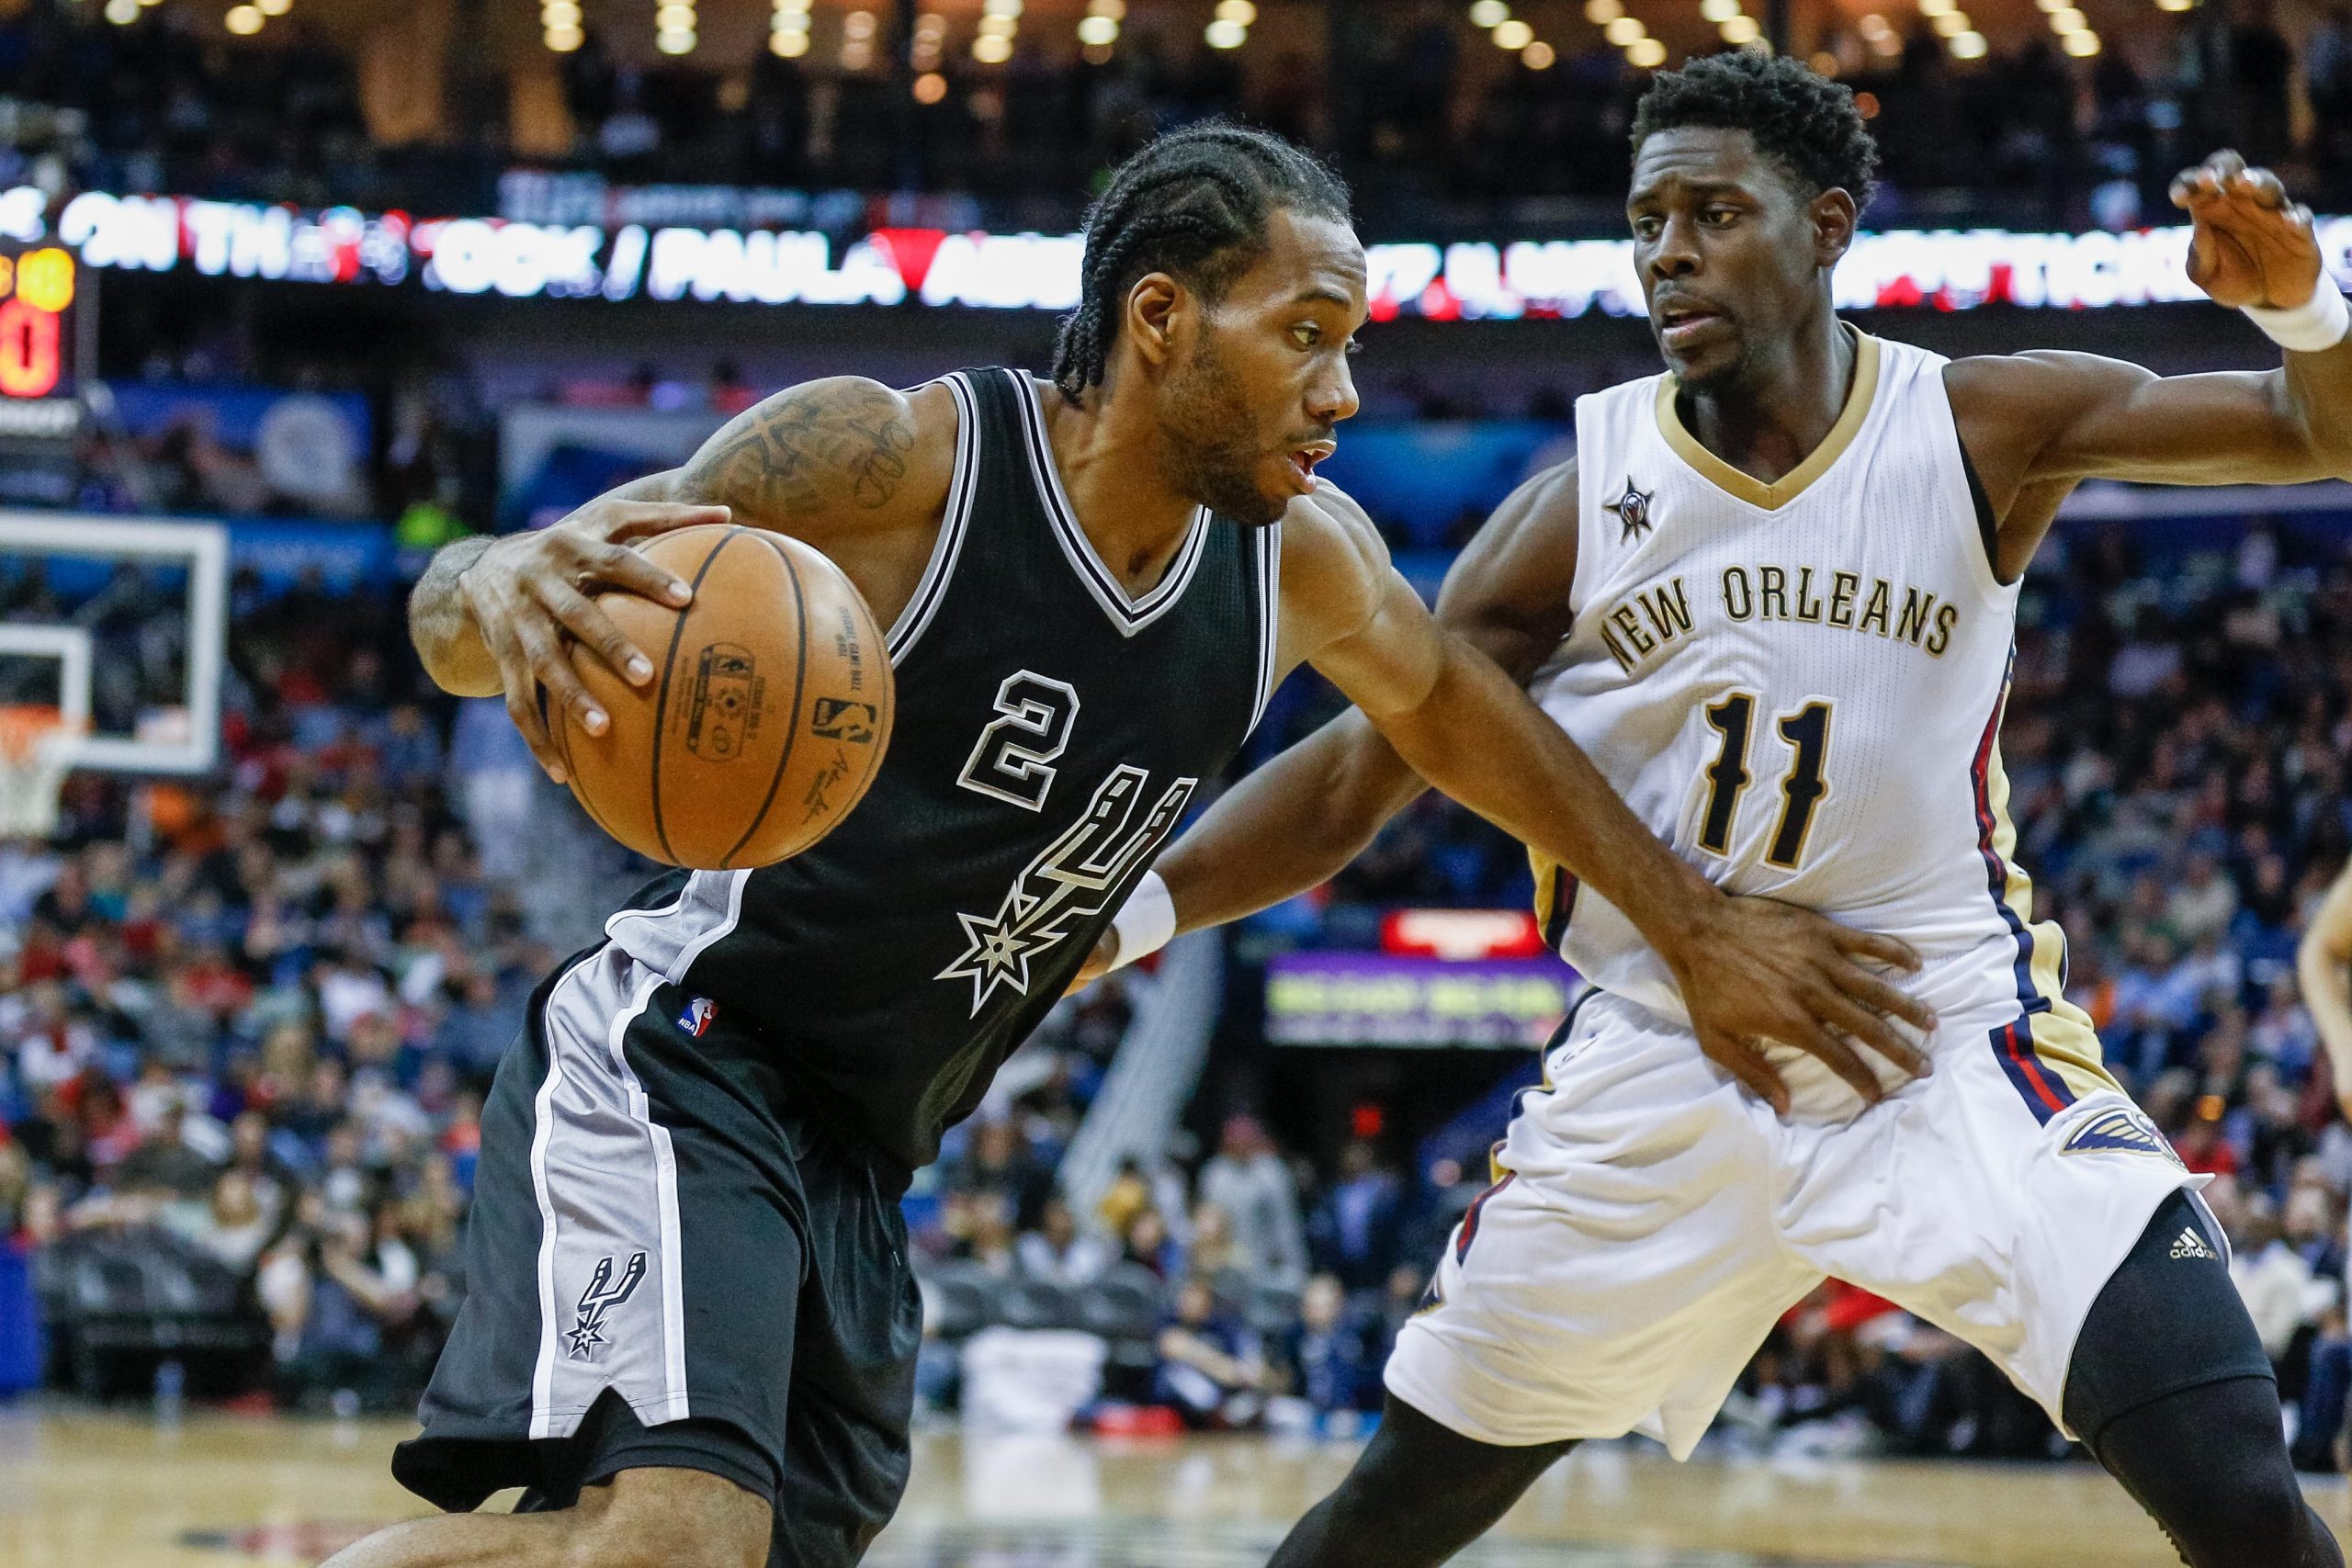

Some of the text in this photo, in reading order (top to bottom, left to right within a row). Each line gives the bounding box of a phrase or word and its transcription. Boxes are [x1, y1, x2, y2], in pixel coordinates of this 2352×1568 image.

[1600, 564, 1958, 677] NEW ORLEANS
[956, 669, 1080, 813] 2
[1697, 690, 1836, 871] 11
[677, 1017, 695, 1032] NBA
